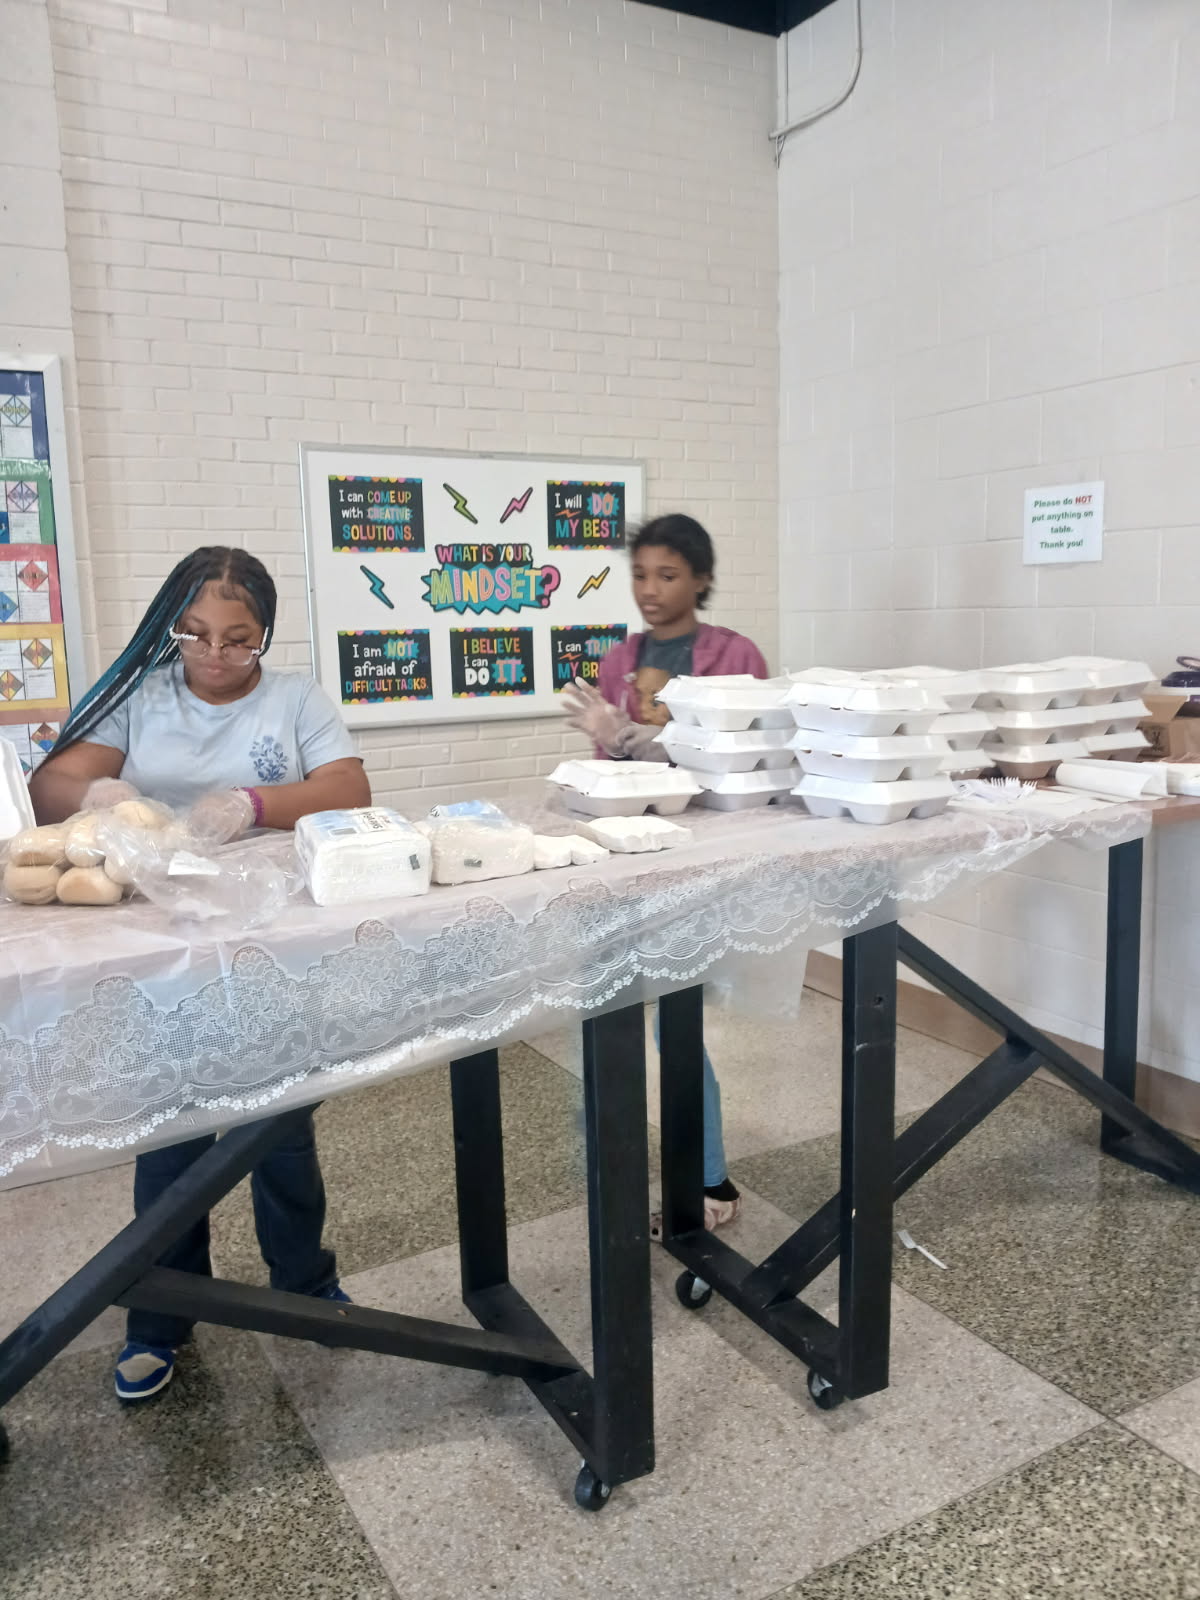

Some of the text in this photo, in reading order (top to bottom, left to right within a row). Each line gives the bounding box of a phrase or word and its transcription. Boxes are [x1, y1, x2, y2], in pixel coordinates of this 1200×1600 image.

[339, 489, 412, 504] I can COME UP
[554, 491, 615, 516] I will DO
[1034, 495, 1092, 508] Please do NOT
[341, 506, 411, 521] with CREATIVE
[1031, 514, 1045, 523] put
[1046, 511, 1081, 521] anything
[342, 524, 415, 541] SOLUTIONS.
[555, 518, 620, 539] MY BEST.
[1050, 525, 1074, 534] table.
[1039, 539, 1084, 549] Thank you!
[437, 544, 532, 562] WHAT IS YOUR
[431, 566, 560, 606] MINDSET?
[353, 640, 415, 658] I am NOT
[463, 637, 521, 655] I BELIEVE
[557, 638, 619, 657] I can TRAI
[354, 660, 418, 677] afraid of
[463, 656, 489, 667] I can
[557, 661, 580, 679] MY
[465, 659, 527, 686] DO IT.
[345, 677, 429, 693] DIFFICULT TASKS.
